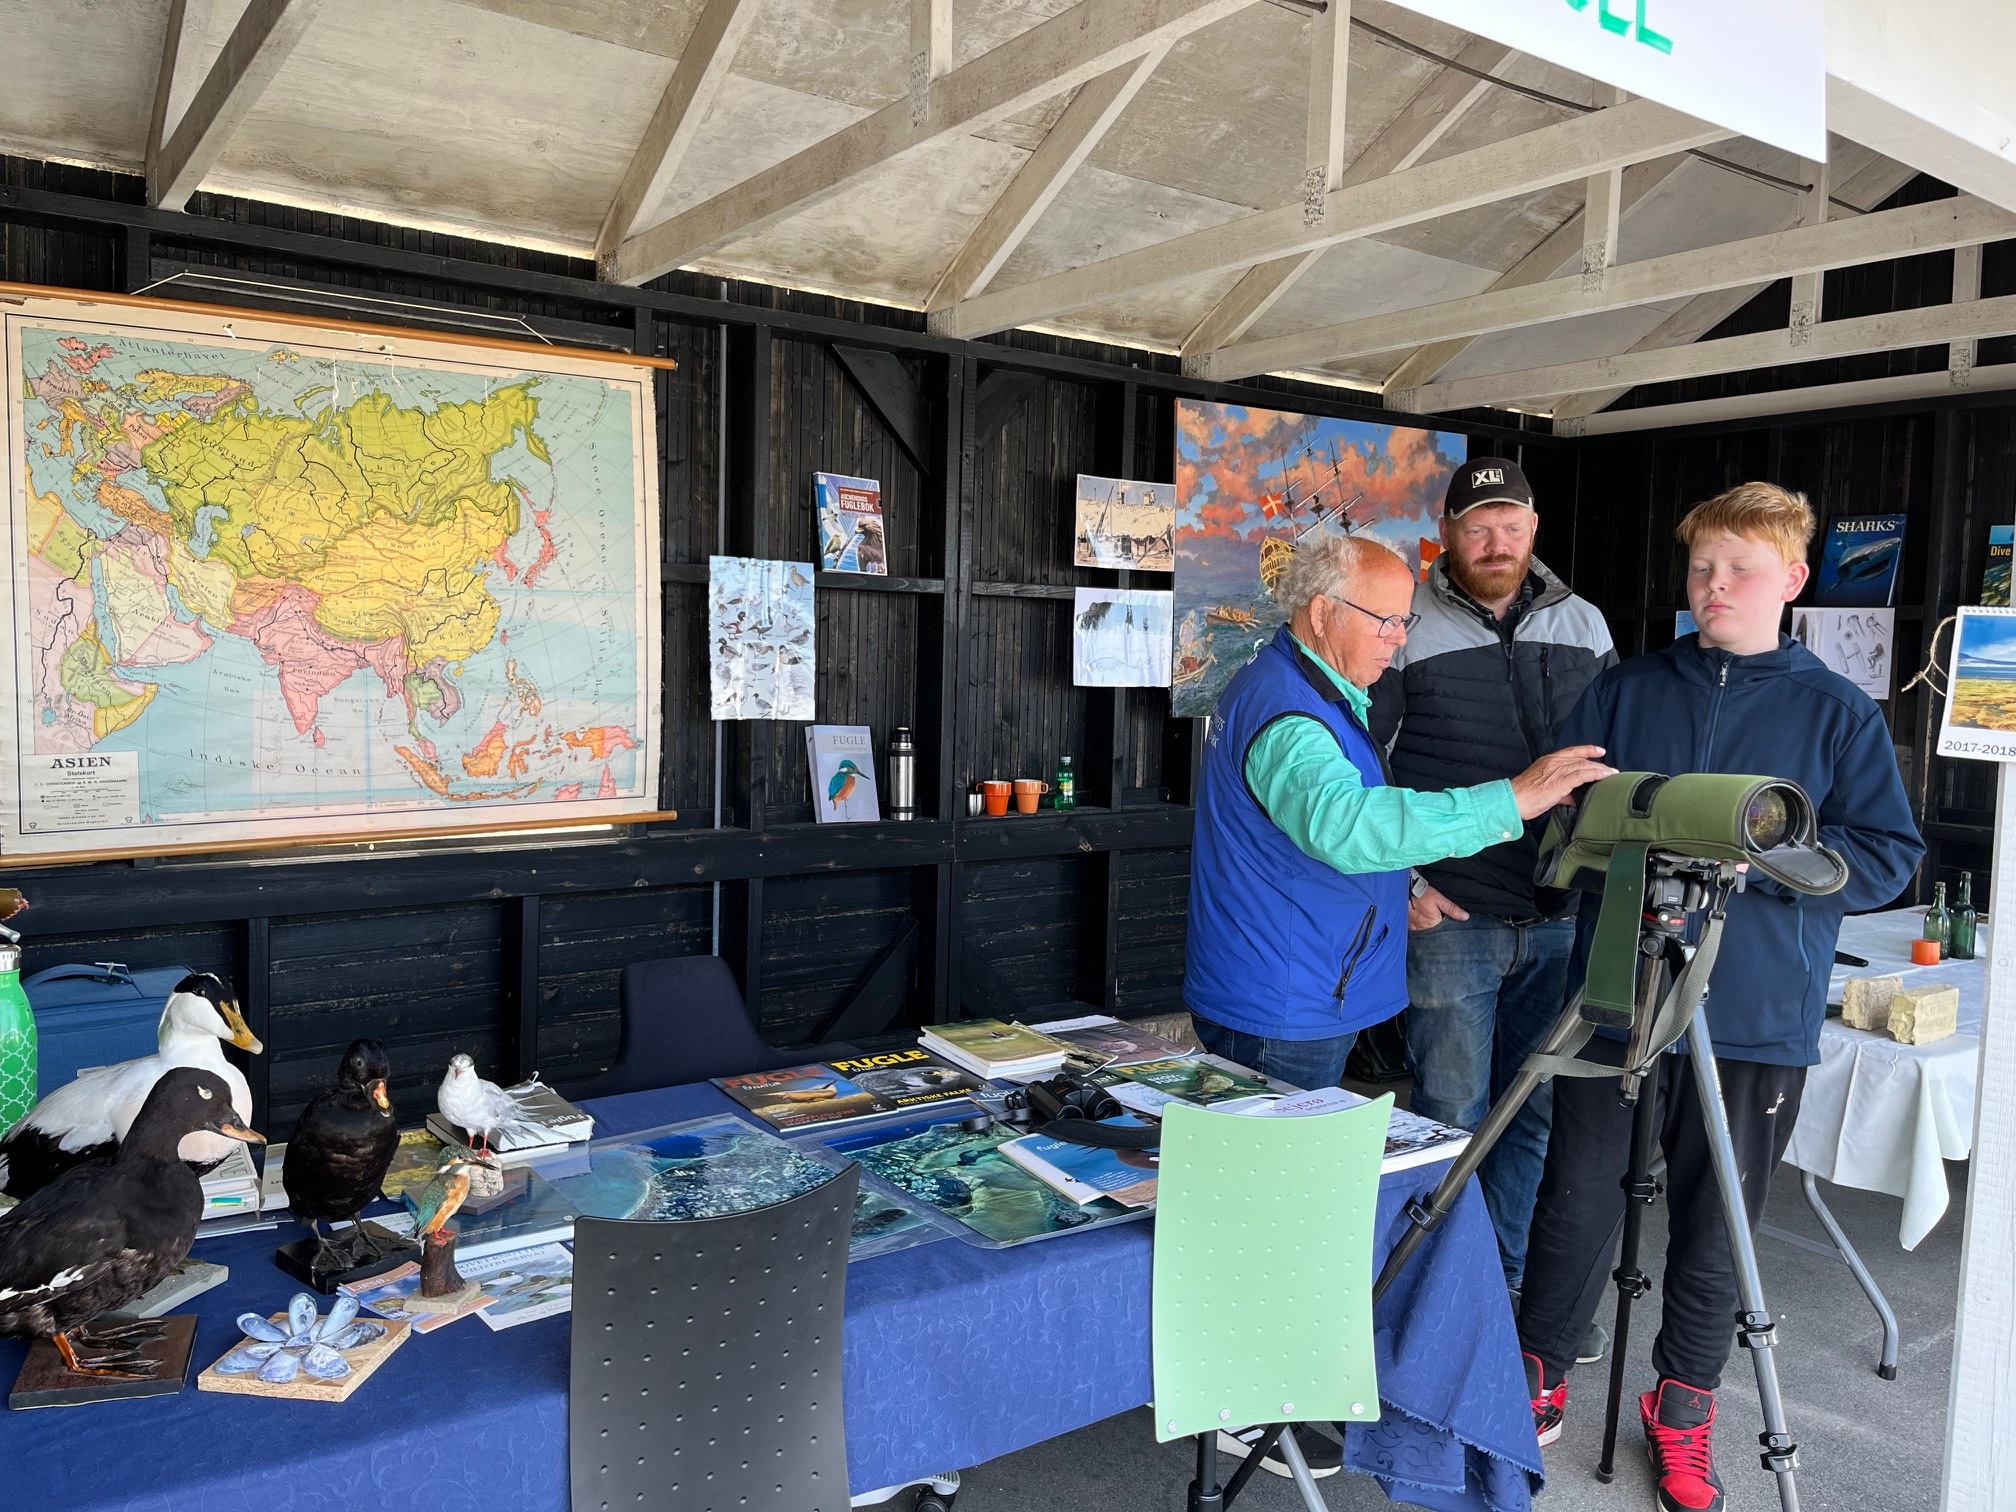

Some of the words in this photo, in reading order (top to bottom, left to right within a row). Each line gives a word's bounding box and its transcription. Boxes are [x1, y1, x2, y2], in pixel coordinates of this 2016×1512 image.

[128, 423, 148, 440] Polen
[841, 500, 875, 512] FUGLEBOK
[1836, 521, 1896, 533] SHARKS
[1990, 545, 2011, 556] Dive
[439, 630, 475, 641] Kina
[832, 736, 867, 745] FUGLE
[1944, 740, 2016, 757] 2017-2018
[50, 757, 111, 769] ASIEN
[189, 749, 275, 771] Indiske
[295, 764, 361, 775] Ocean
[831, 1049, 930, 1071] FUGLE
[722, 1066, 829, 1089] FUGLE
[896, 1091, 943, 1105] ARKTISKE
[944, 1087, 974, 1097] FALKE
[1036, 1141, 1068, 1152] fugle
